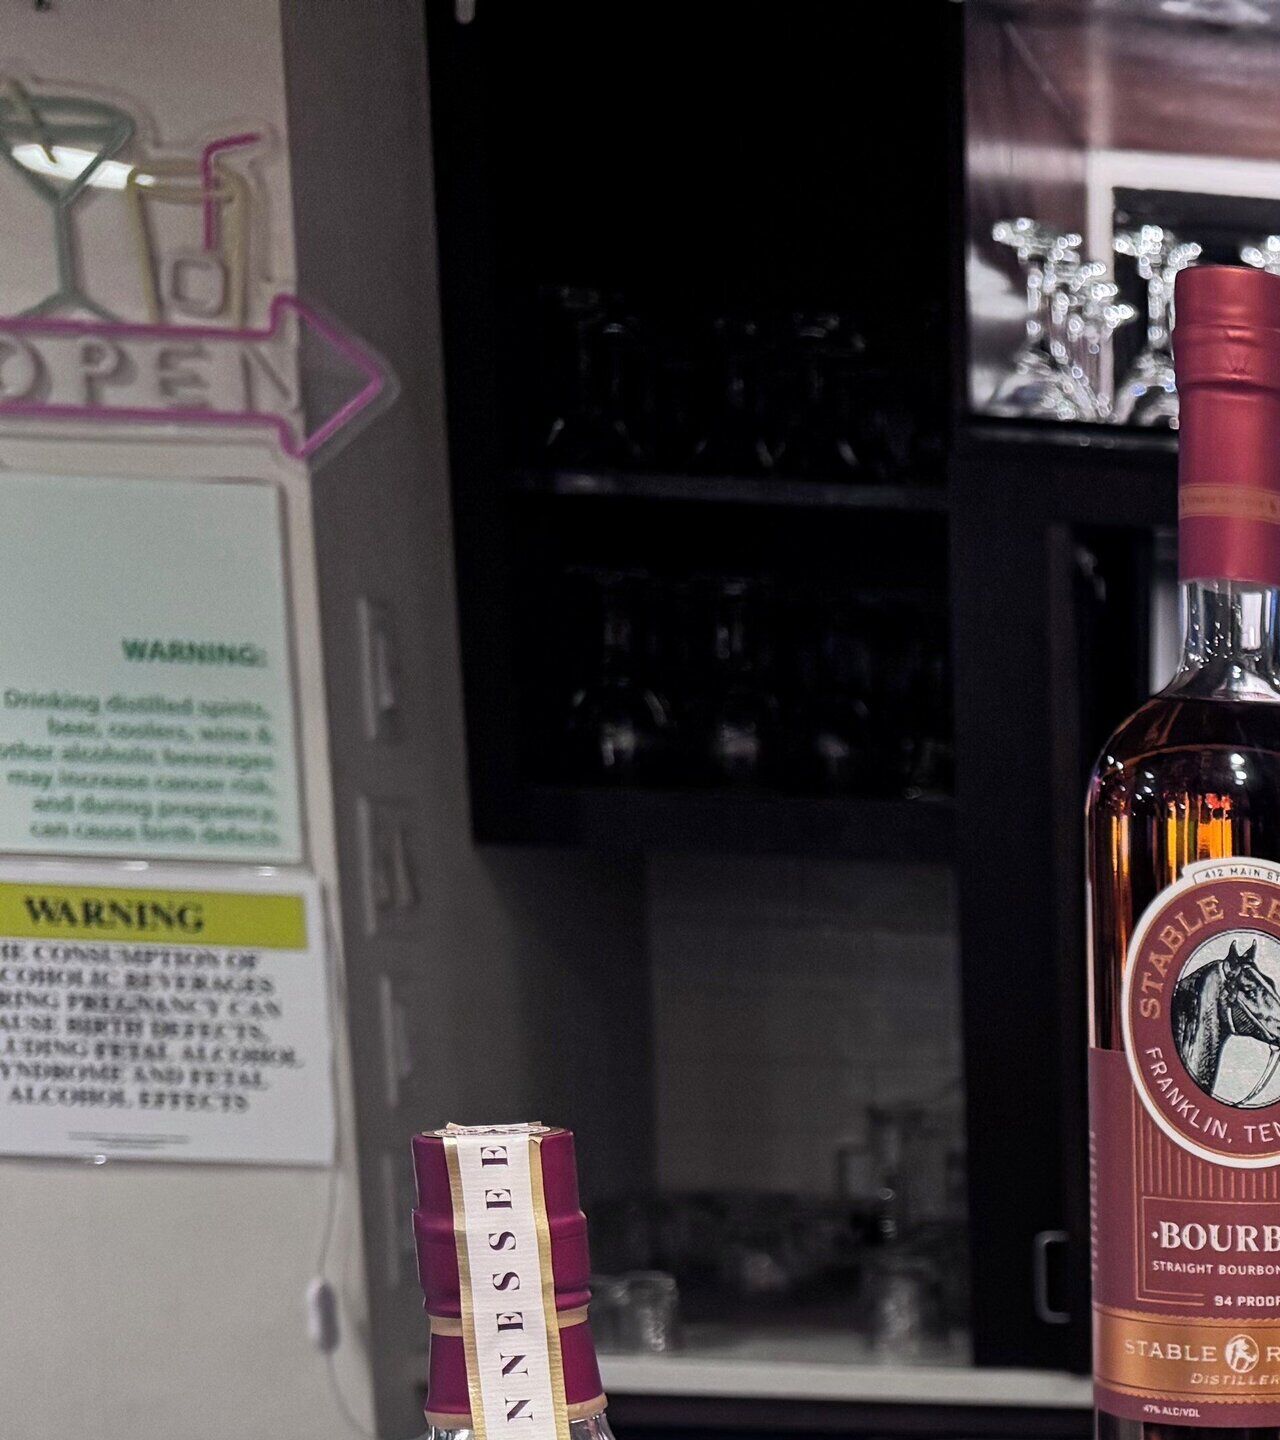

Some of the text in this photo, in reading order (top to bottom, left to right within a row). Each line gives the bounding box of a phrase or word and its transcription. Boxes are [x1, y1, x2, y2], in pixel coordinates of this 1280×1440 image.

[1204, 867, 1224, 879] 412
[25, 896, 204, 933] WARNING
[1138, 894, 1225, 1021] STABLE
[1146, 1046, 1233, 1144] FRANKLIN,
[1152, 1260, 1214, 1275] STRAIGHT
[1124, 1339, 1218, 1362] STABLE
